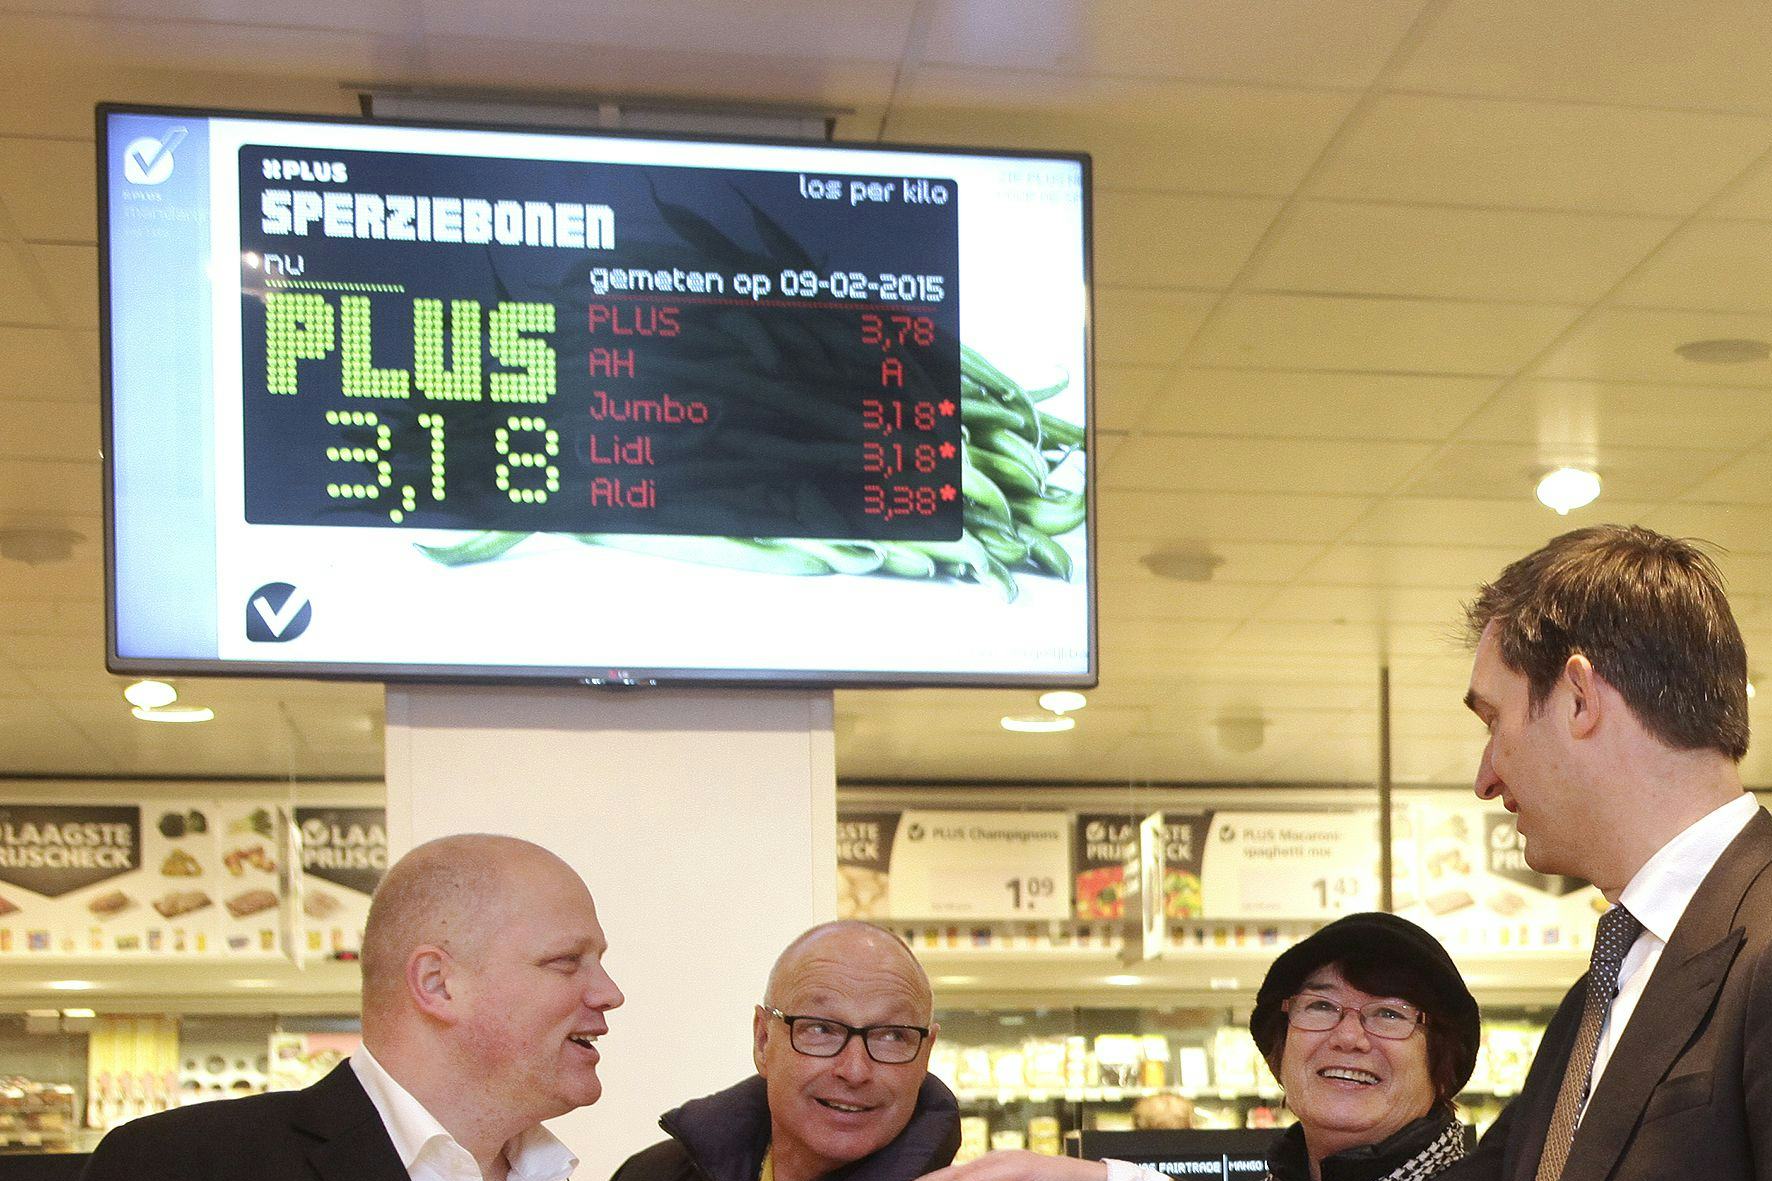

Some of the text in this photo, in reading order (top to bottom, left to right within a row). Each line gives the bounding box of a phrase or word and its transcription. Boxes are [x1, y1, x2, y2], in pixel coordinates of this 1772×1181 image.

[285, 160, 348, 184] PLUS
[799, 174, 949, 207] los per kilo
[261, 188, 616, 250] SPERZIEBONEN
[264, 252, 305, 277] nu
[590, 267, 945, 303] gemeten op 09-02-2015
[588, 304, 936, 352] PLUS 3,78
[266, 292, 558, 404] PLUS
[588, 348, 636, 379] AH
[590, 391, 709, 425] Jumbo
[326, 409, 560, 524] 3,18
[590, 434, 656, 466] Lidl
[590, 477, 657, 510] Aldi
[1158, 1160, 1222, 1175] FAIRTRADE
[1227, 1159, 1264, 1172] MANGO
